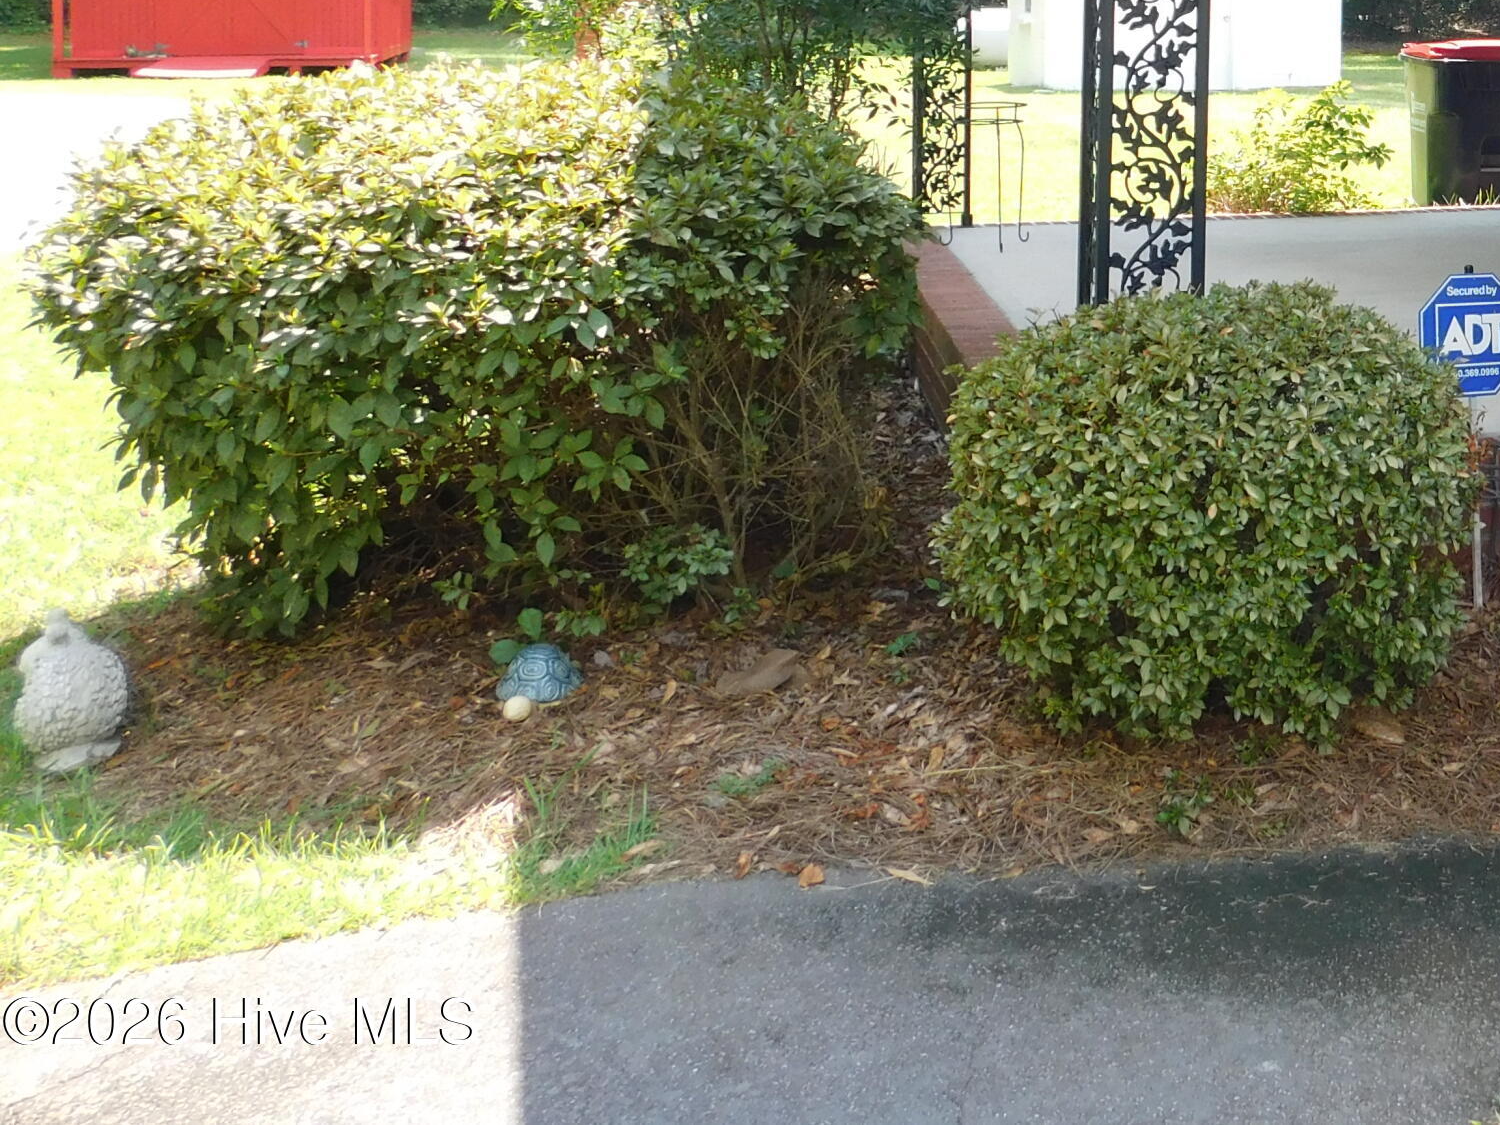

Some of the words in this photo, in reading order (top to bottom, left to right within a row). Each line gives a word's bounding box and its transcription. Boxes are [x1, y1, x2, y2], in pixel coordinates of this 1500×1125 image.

[1446, 285, 1485, 296] Secured
[1486, 285, 1497, 296] by
[1456, 368, 1499, 377] 0.369.0996
